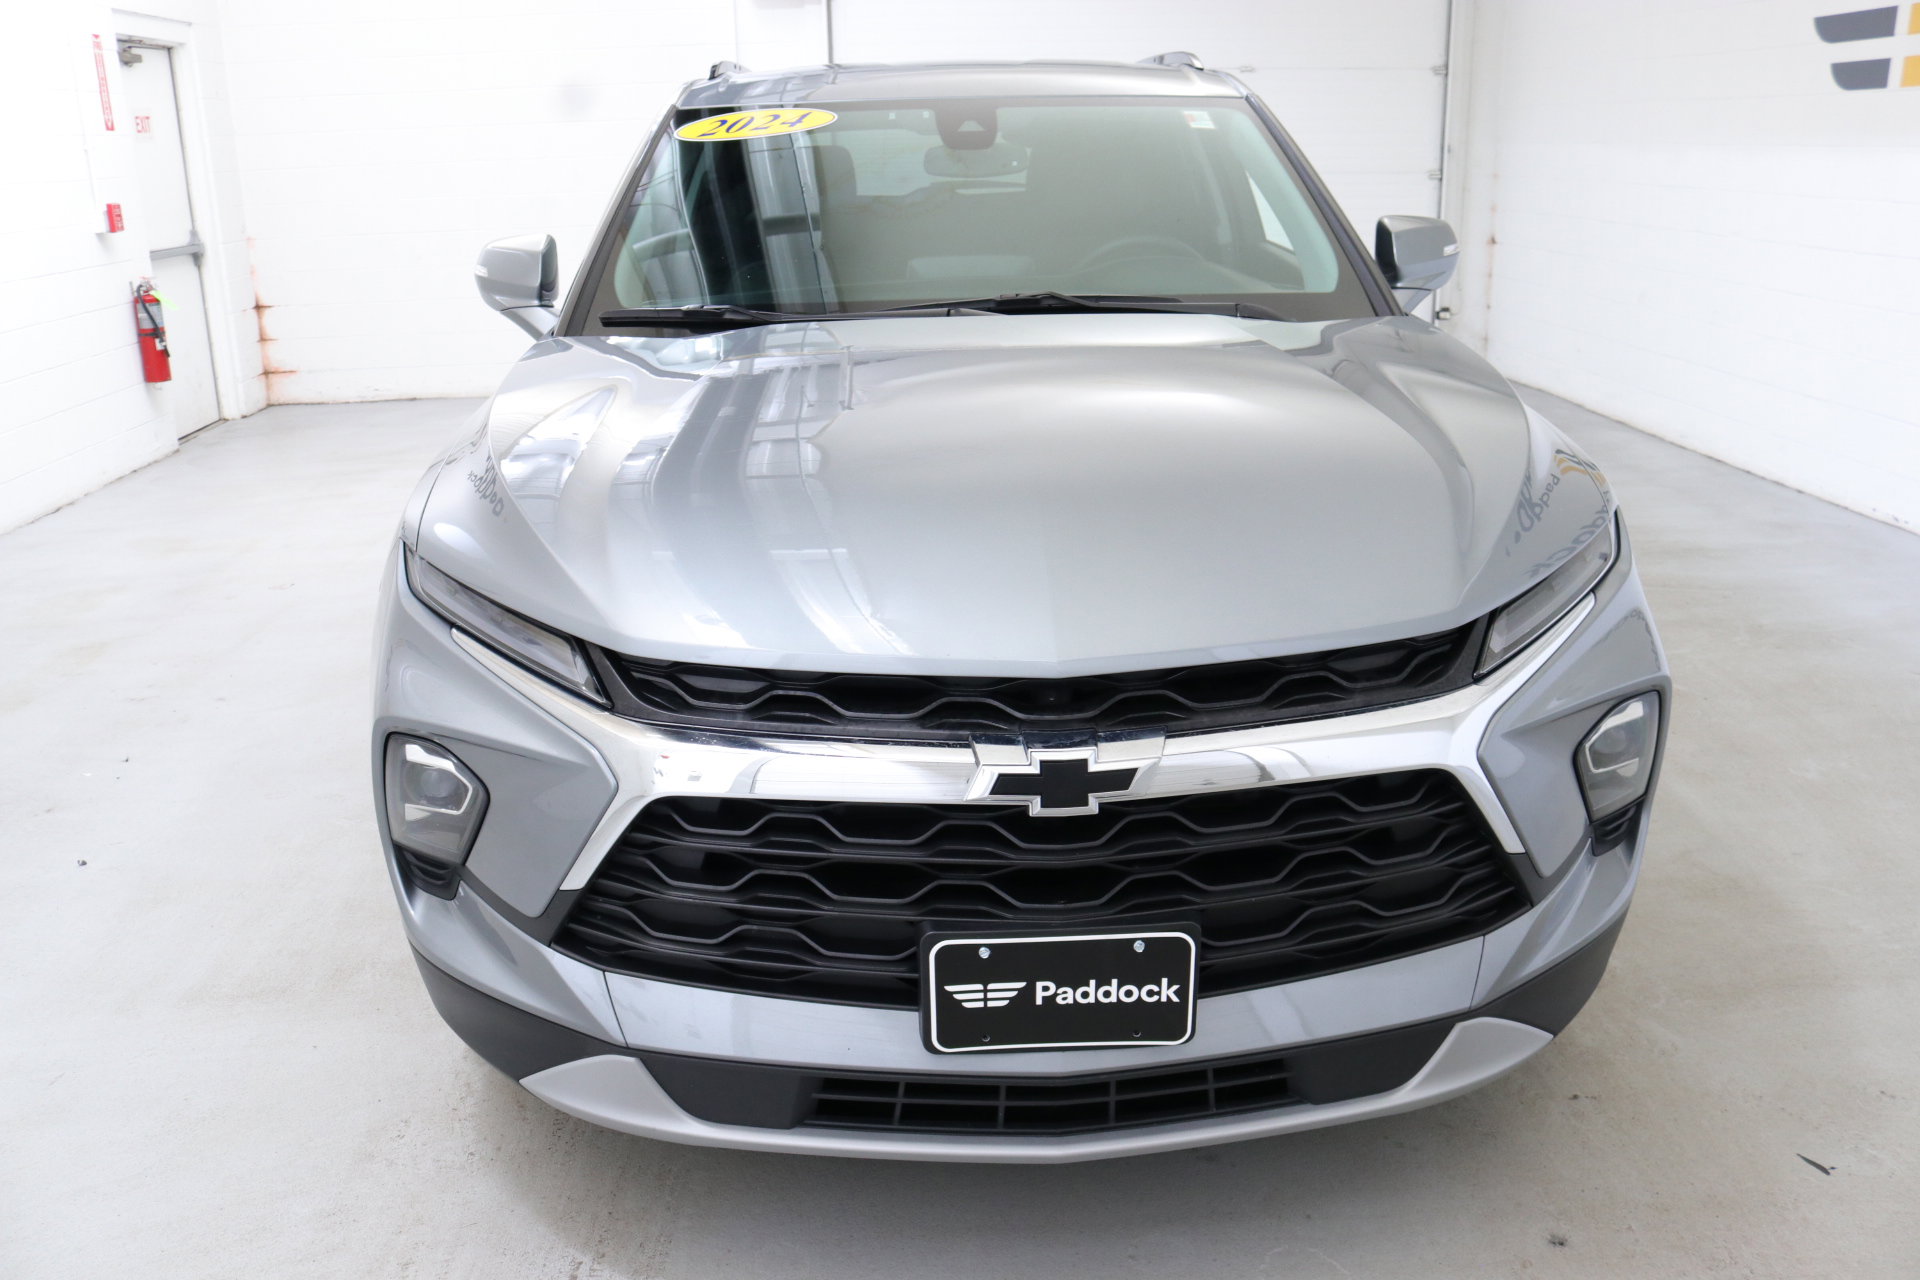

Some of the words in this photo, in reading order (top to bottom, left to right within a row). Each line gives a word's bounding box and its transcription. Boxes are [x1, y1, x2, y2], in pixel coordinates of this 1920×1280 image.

[134, 116, 151, 133] EXIT
[697, 111, 812, 137] 2024
[1035, 977, 1181, 1006] Paddock
